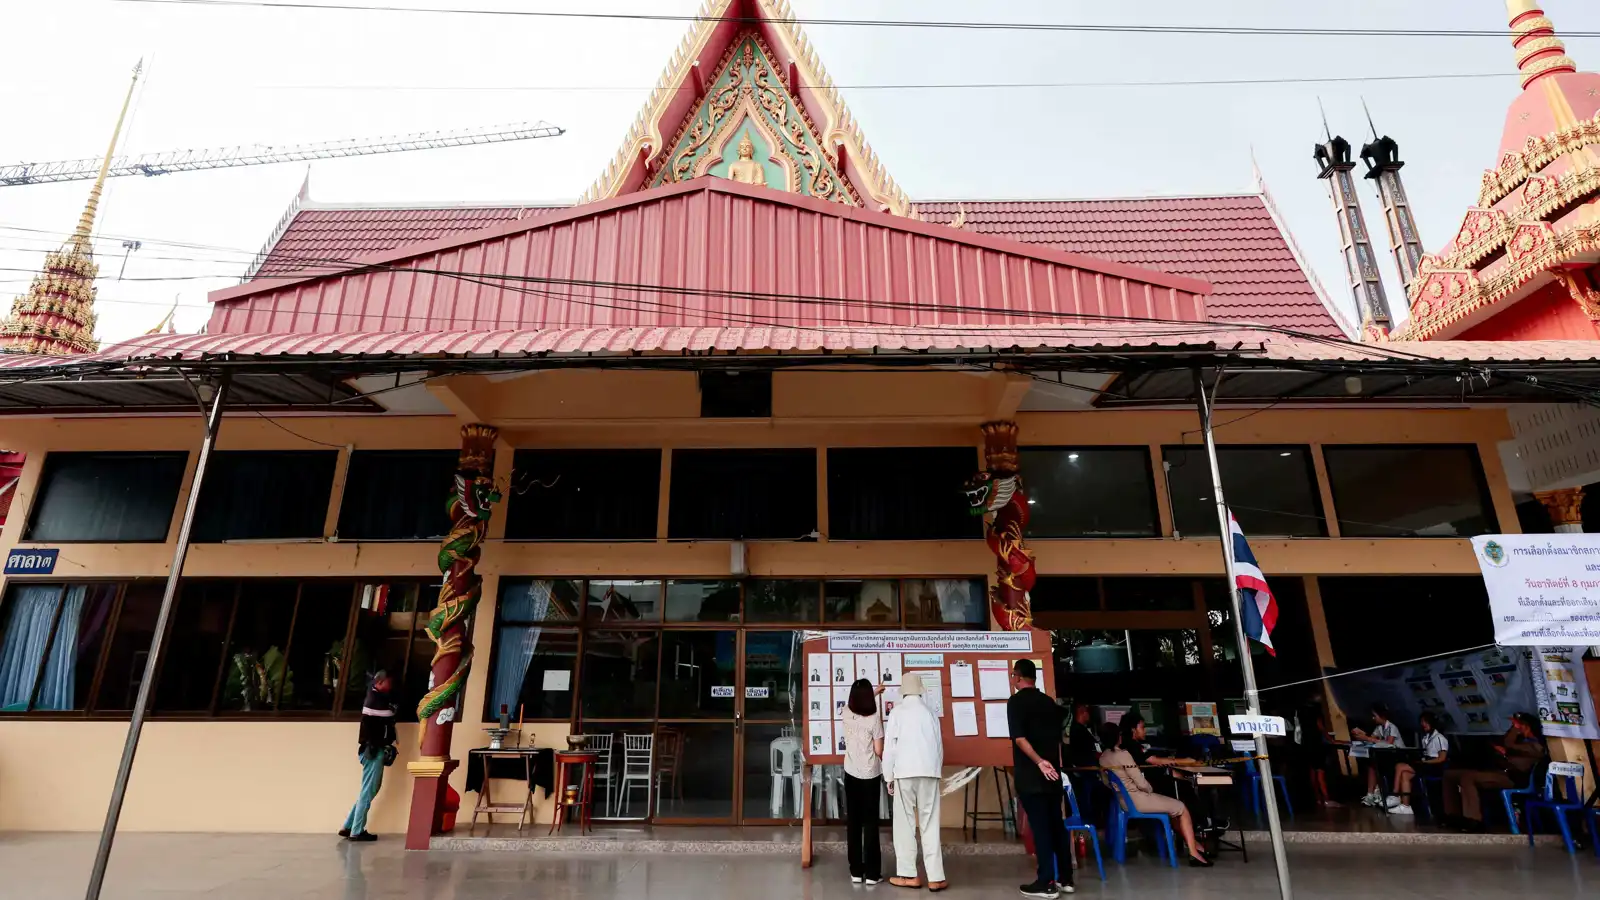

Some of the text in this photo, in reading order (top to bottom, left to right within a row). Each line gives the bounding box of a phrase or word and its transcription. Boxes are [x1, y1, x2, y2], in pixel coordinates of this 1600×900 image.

[1525, 576, 1570, 588] วันอาทิตย์ที่
[1572, 580, 1578, 588] 8
[1236, 717, 1280, 732] ทางเข้า
